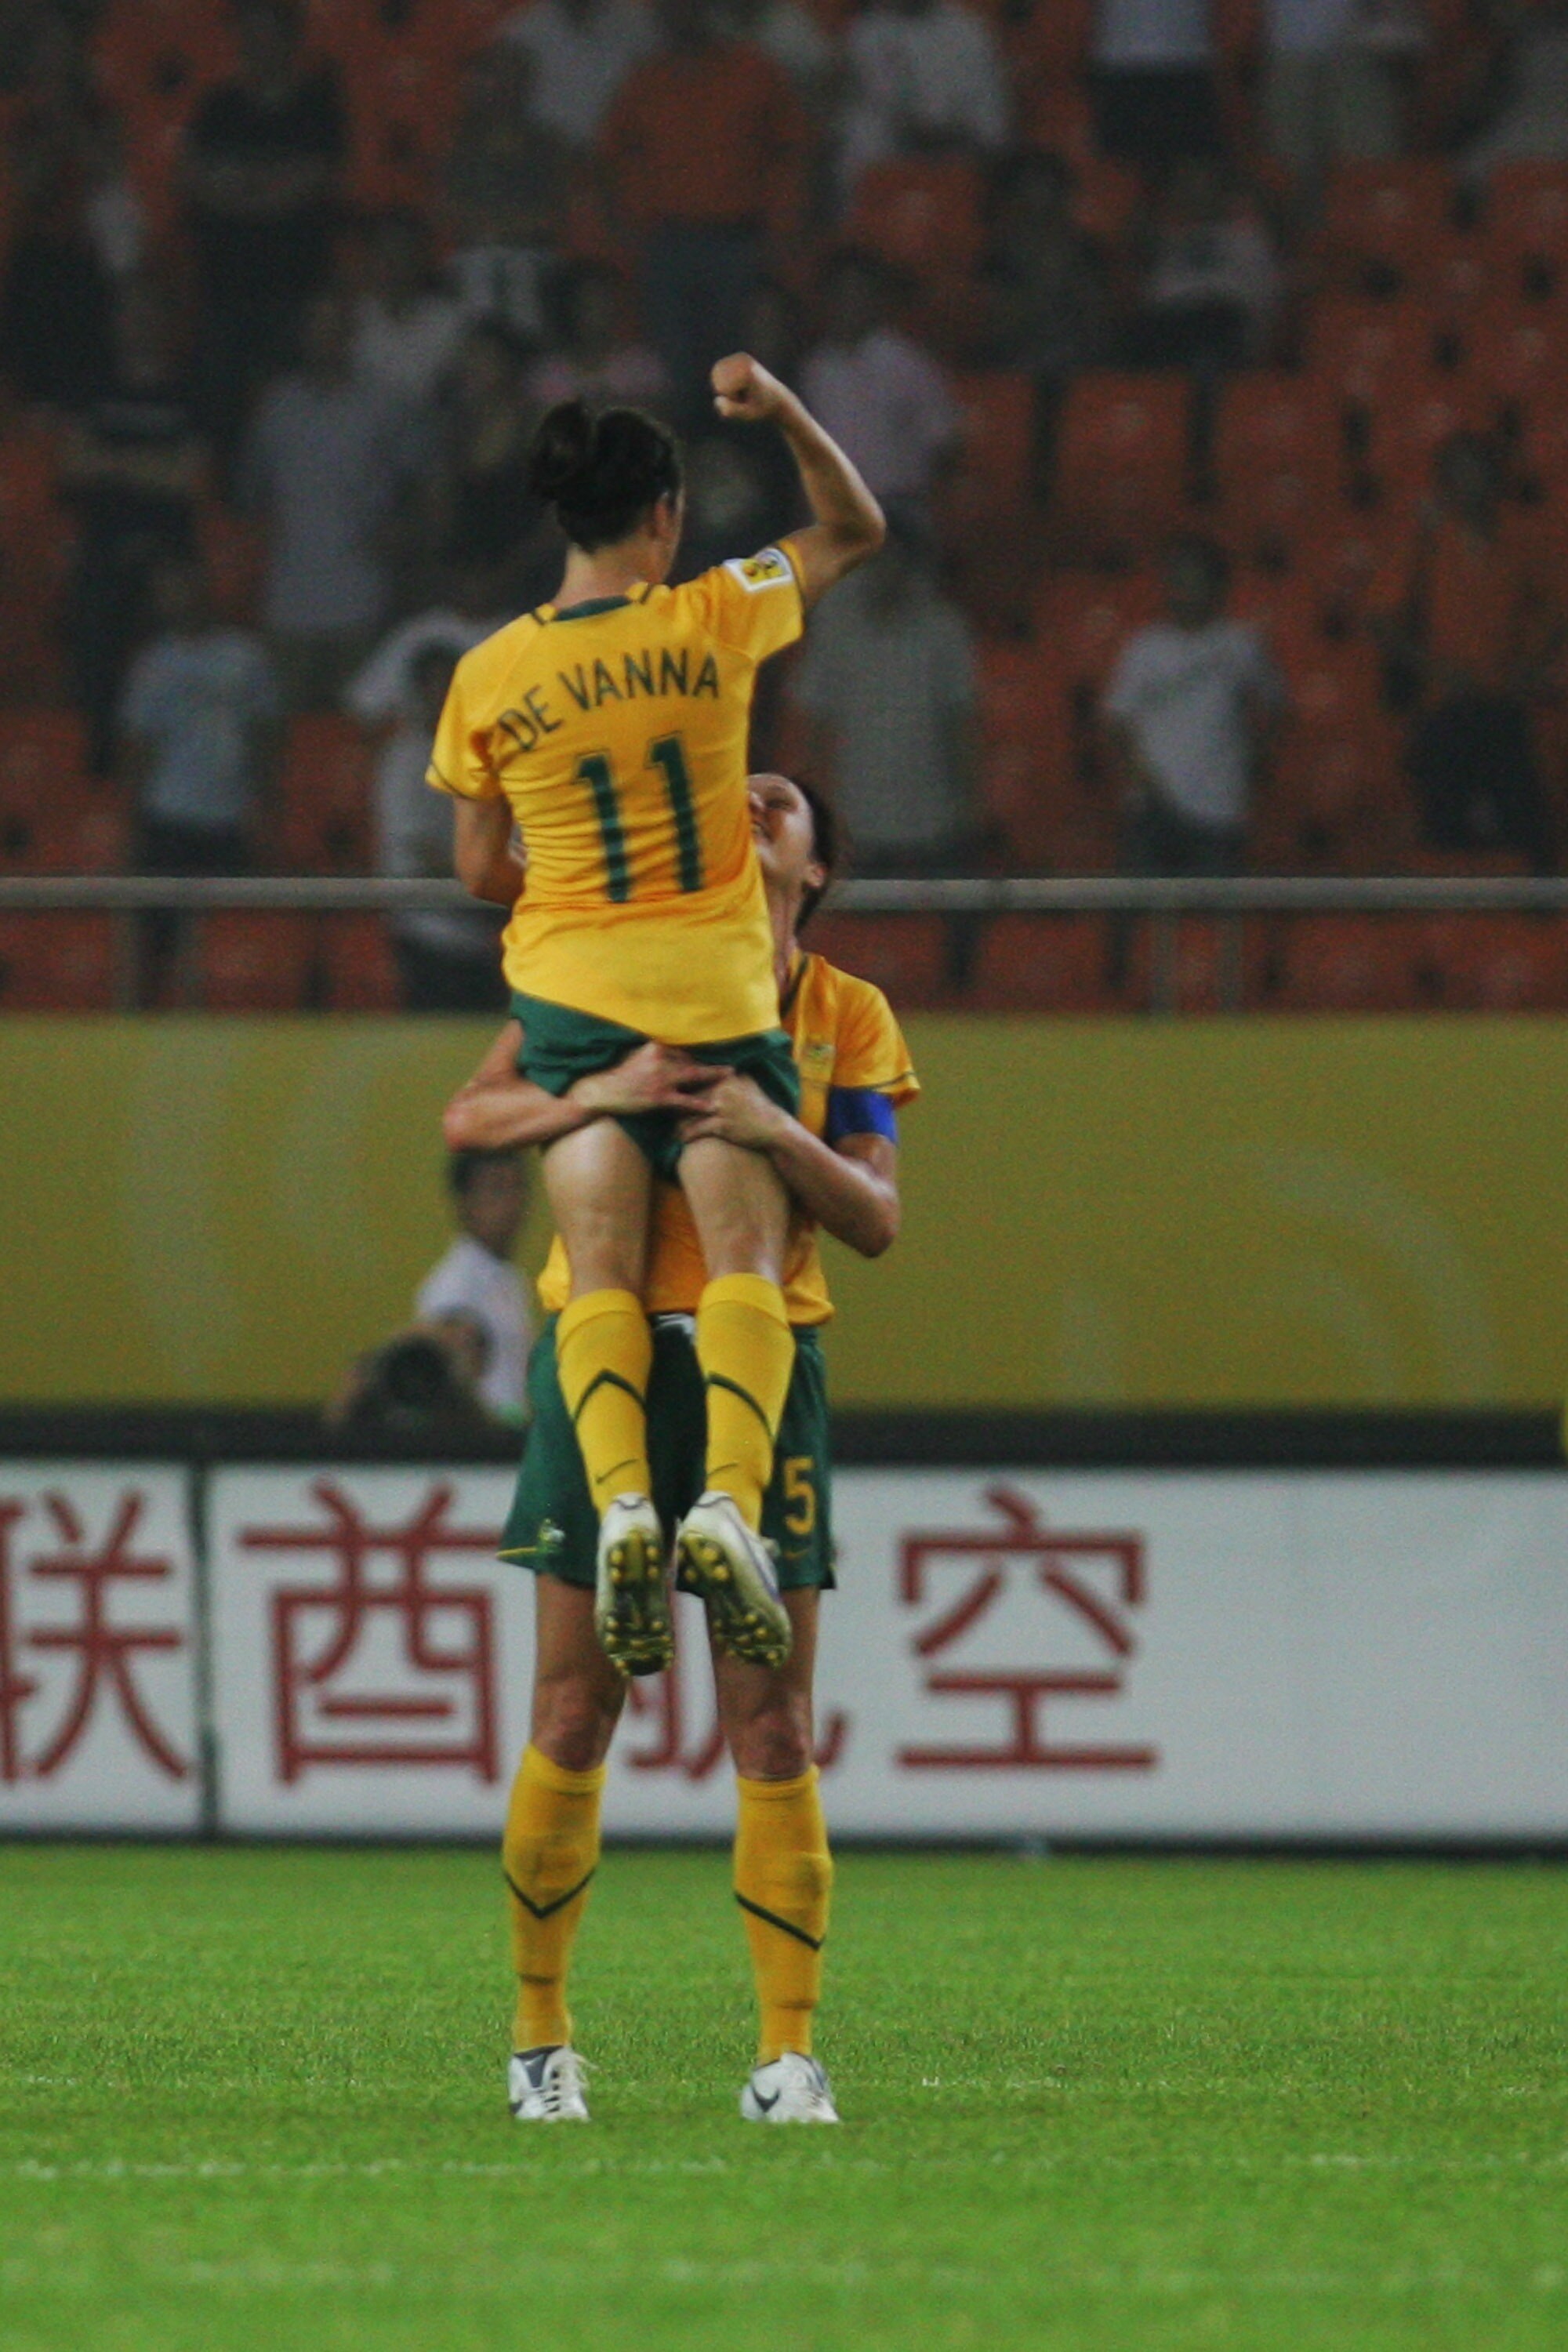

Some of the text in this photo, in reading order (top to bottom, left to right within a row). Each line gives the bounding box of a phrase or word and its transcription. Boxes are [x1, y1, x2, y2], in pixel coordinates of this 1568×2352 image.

[499, 648, 719, 750] DE VANNA
[571, 731, 702, 903] 11
[785, 1457, 816, 1535] 5
[0, 1479, 1159, 1785] 联酋空
